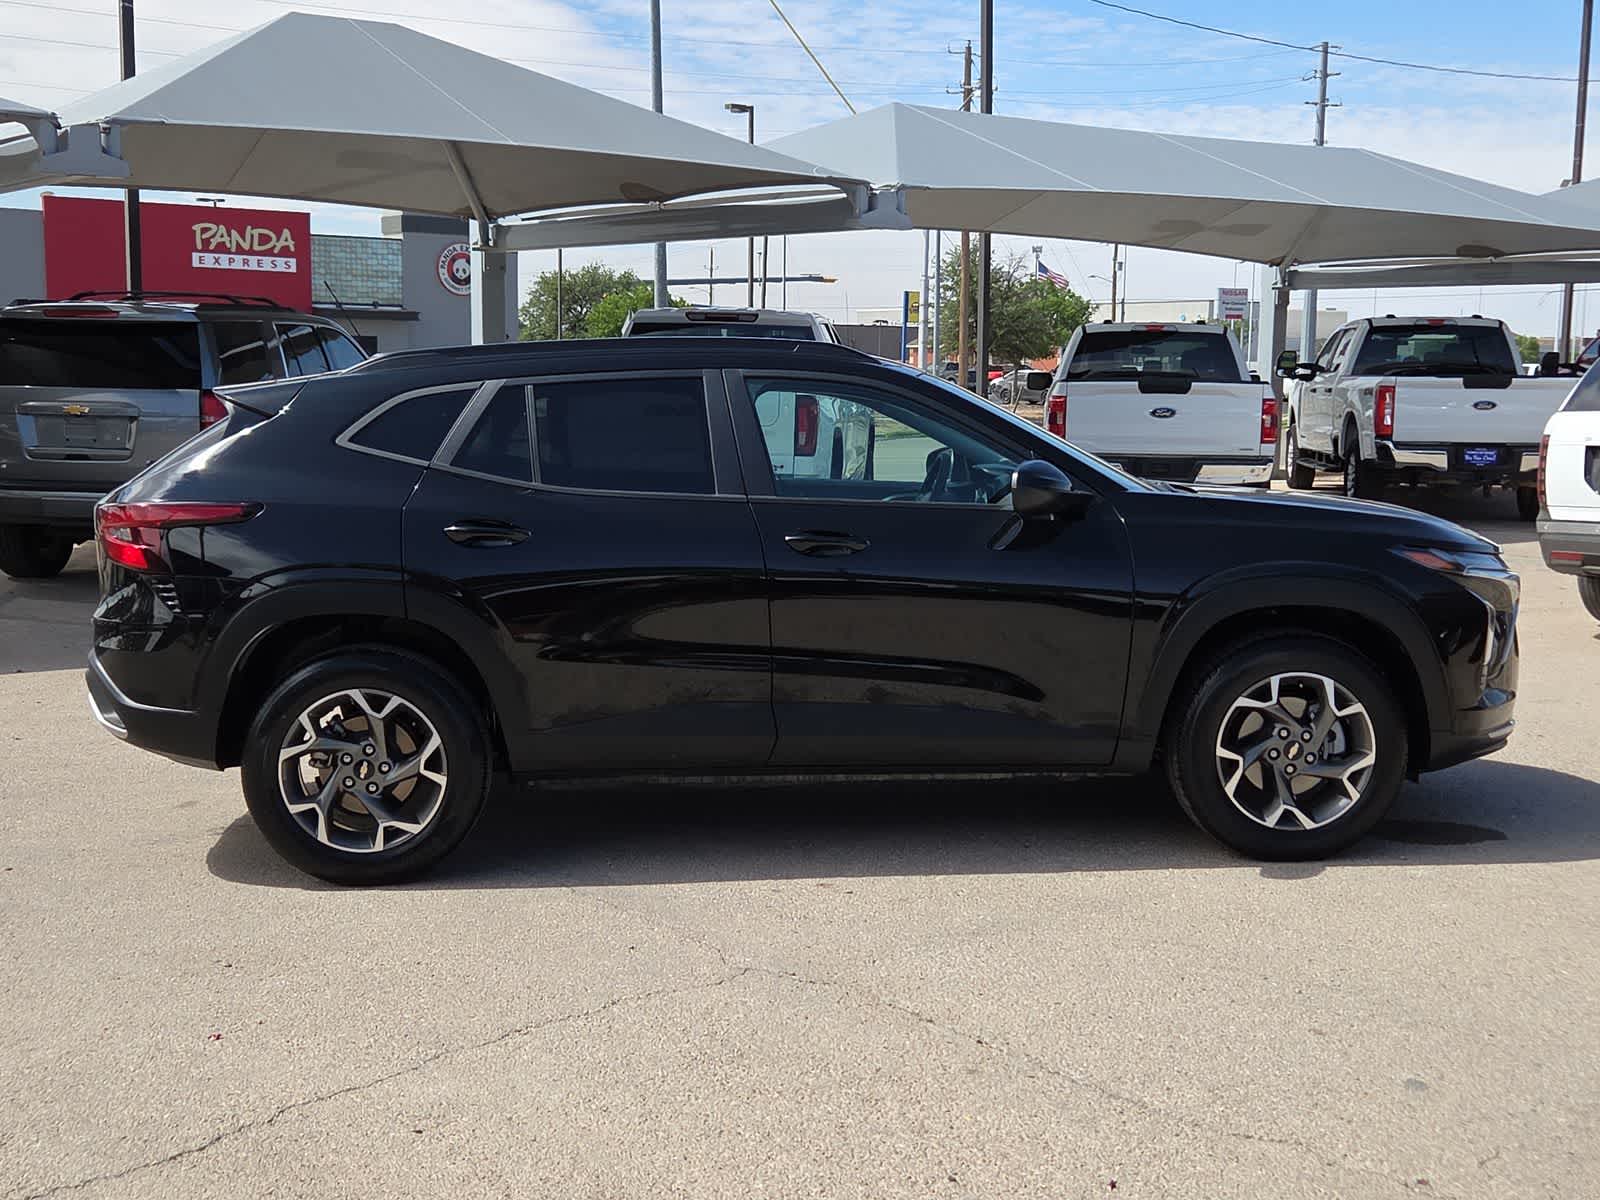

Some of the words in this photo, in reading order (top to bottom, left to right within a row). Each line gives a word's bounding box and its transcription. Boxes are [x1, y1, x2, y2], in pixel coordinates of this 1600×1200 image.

[192, 223, 295, 253] PANDA
[198, 255, 292, 270] EXPRESS
[440, 246, 458, 269] PANDA
[1222, 289, 1248, 297] NISSAN
